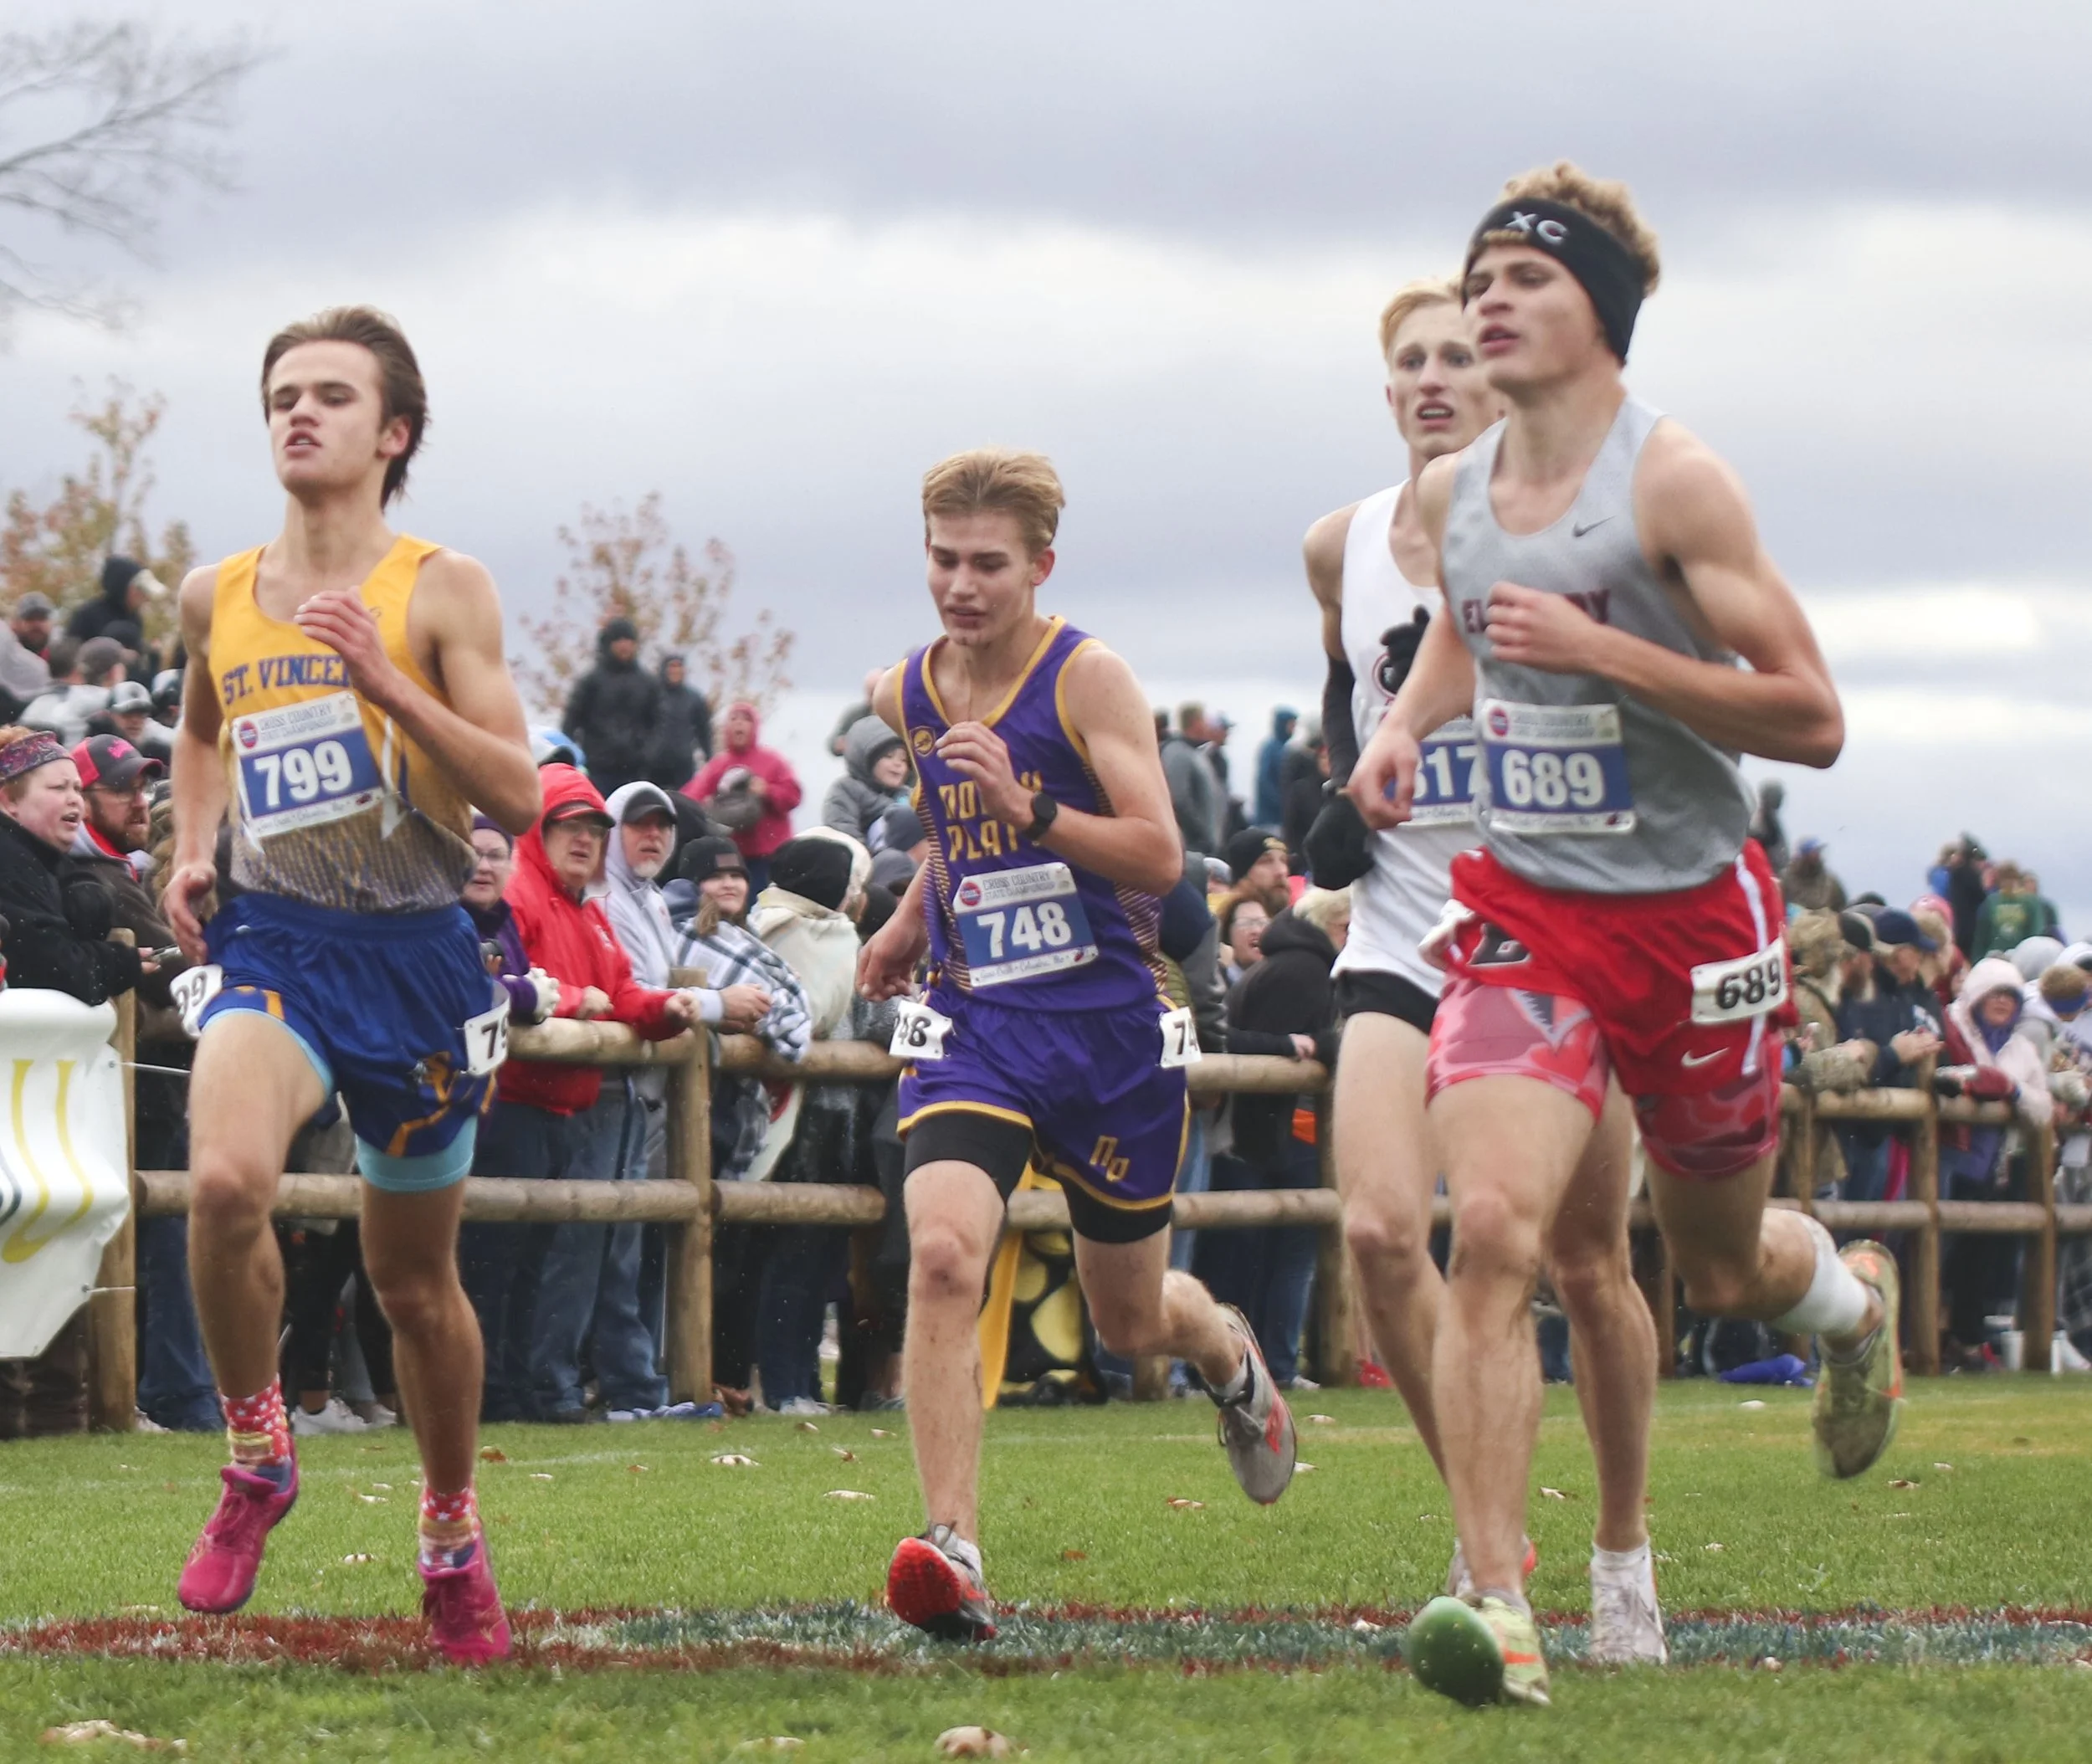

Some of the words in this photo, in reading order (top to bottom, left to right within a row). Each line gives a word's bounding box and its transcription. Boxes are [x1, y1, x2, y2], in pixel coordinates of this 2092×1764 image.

[1505, 211, 1569, 245] XC
[222, 663, 254, 705] ST.
[254, 740, 352, 809] 799
[1502, 749, 1605, 808] 689
[982, 876, 1010, 891] CROSS
[1011, 870, 1051, 885] COUNTRY
[977, 901, 1071, 958] 748
[1716, 956, 1781, 1009] 689
[1173, 1020, 1197, 1055] 74
